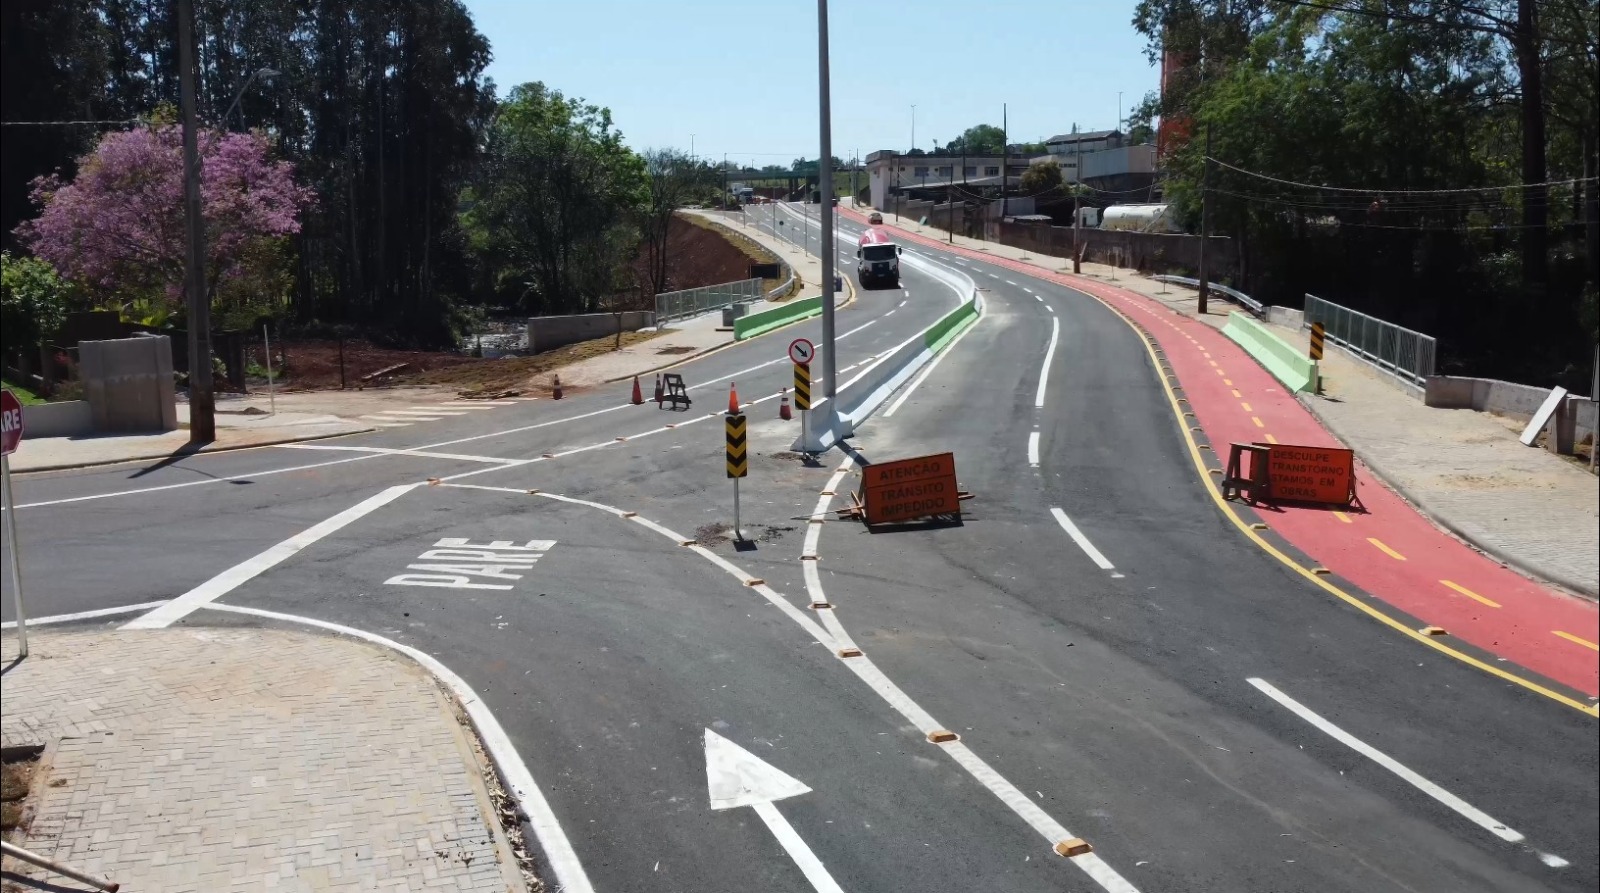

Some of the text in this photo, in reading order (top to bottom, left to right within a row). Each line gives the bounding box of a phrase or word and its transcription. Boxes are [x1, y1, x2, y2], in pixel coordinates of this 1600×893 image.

[1273, 451, 1329, 462] DESCULPE
[1272, 462, 1344, 476] TRANSTORNO
[1319, 477, 1335, 487] EM
[1280, 487, 1317, 498] OBRAS
[881, 497, 945, 516] IMPEDIDO
[383, 538, 557, 590] PARE
